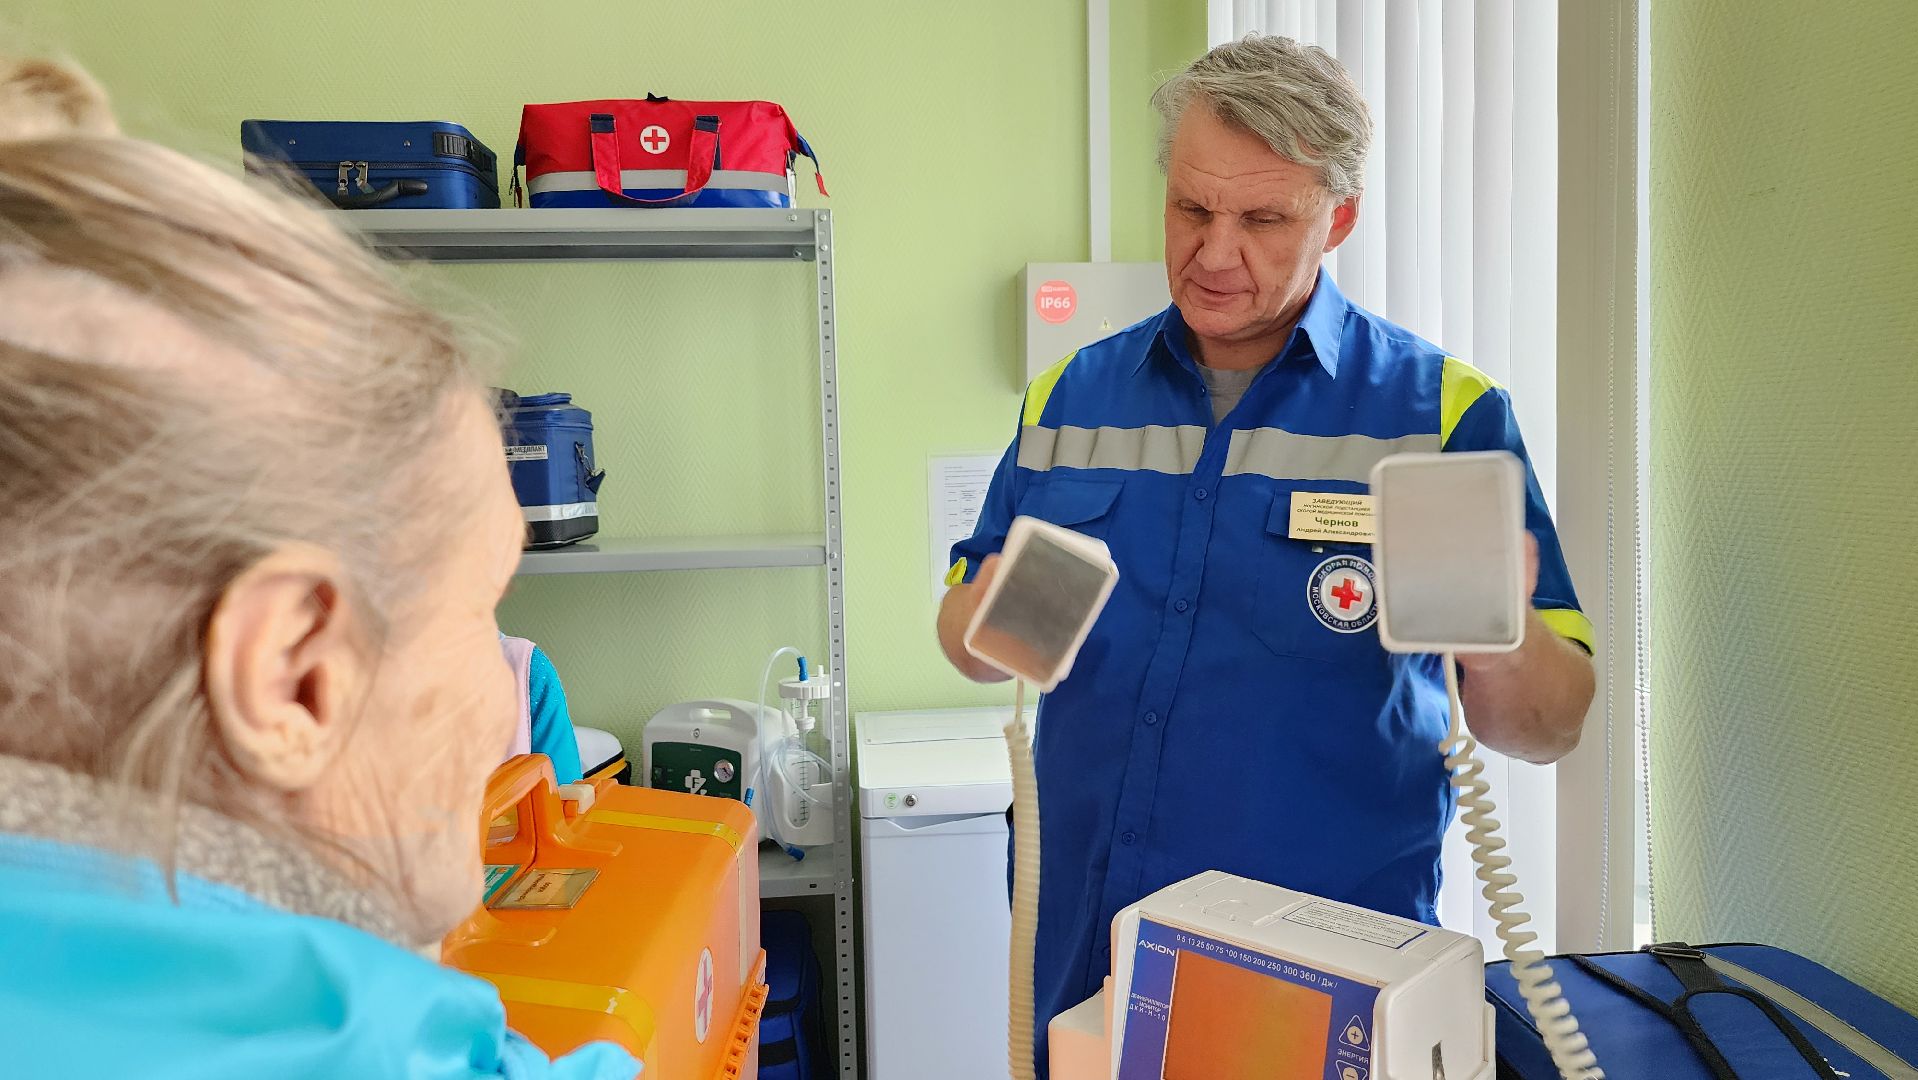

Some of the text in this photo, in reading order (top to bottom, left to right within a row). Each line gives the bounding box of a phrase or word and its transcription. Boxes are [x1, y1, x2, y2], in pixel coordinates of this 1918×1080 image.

[1041, 296, 1070, 309] IP66
[1312, 498, 1363, 506] ЗАВЕДУЮЩИЙ
[1315, 516, 1359, 528] Чернов
[1317, 559, 1348, 580] СКОРАЯ
[1312, 586, 1349, 628] МОСКОВСКАЯ
[1138, 939, 1176, 957] AXION
[1196, 940, 1205, 949] 25
[1205, 942, 1214, 951] 50
[1215, 945, 1224, 954] 75
[1225, 948, 1238, 959] 100
[1239, 953, 1252, 963] 150
[1252, 957, 1266, 967] 200
[1267, 961, 1281, 972] 250
[1283, 965, 1298, 977] 300
[1299, 970, 1316, 982] 360
[1337, 1048, 1369, 1064] ЭНЕРГИЯ
